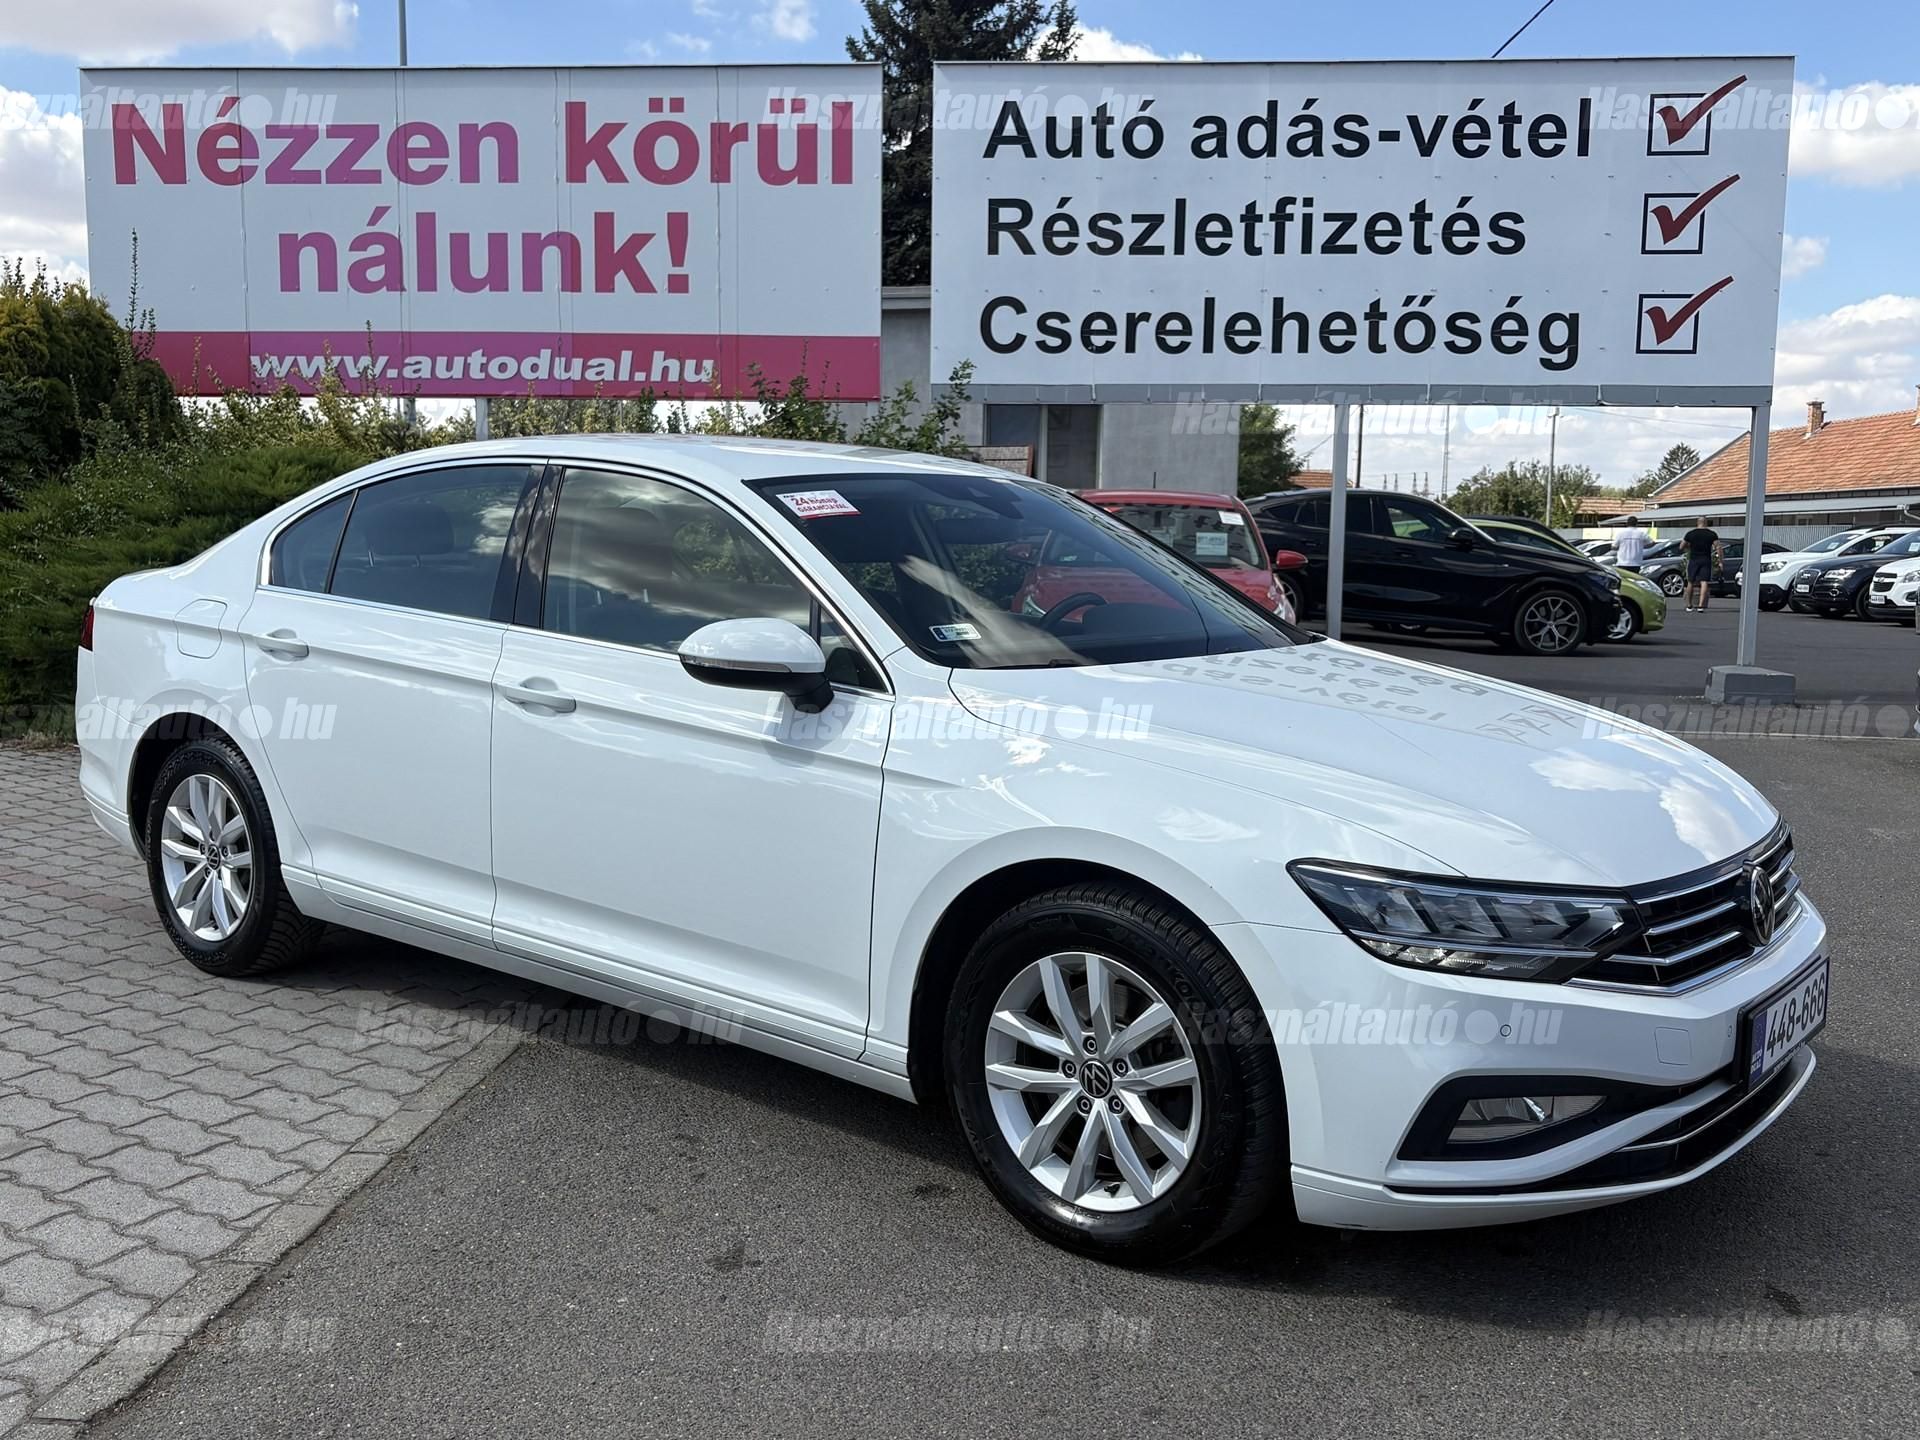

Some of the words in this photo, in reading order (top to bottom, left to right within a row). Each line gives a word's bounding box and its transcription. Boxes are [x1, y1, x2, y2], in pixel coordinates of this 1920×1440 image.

[113, 97, 518, 185] Nézzen
[567, 99, 852, 185] körül
[982, 99, 1164, 160] Autó
[1190, 97, 1592, 160] adás-vétel
[281, 205, 689, 293] nálunk!
[987, 195, 1526, 257] Részletfizetés
[250, 348, 715, 384] www.autodual.hu
[979, 294, 1580, 372] Cserelehetőség
[1766, 972, 1825, 1058] 448-666
